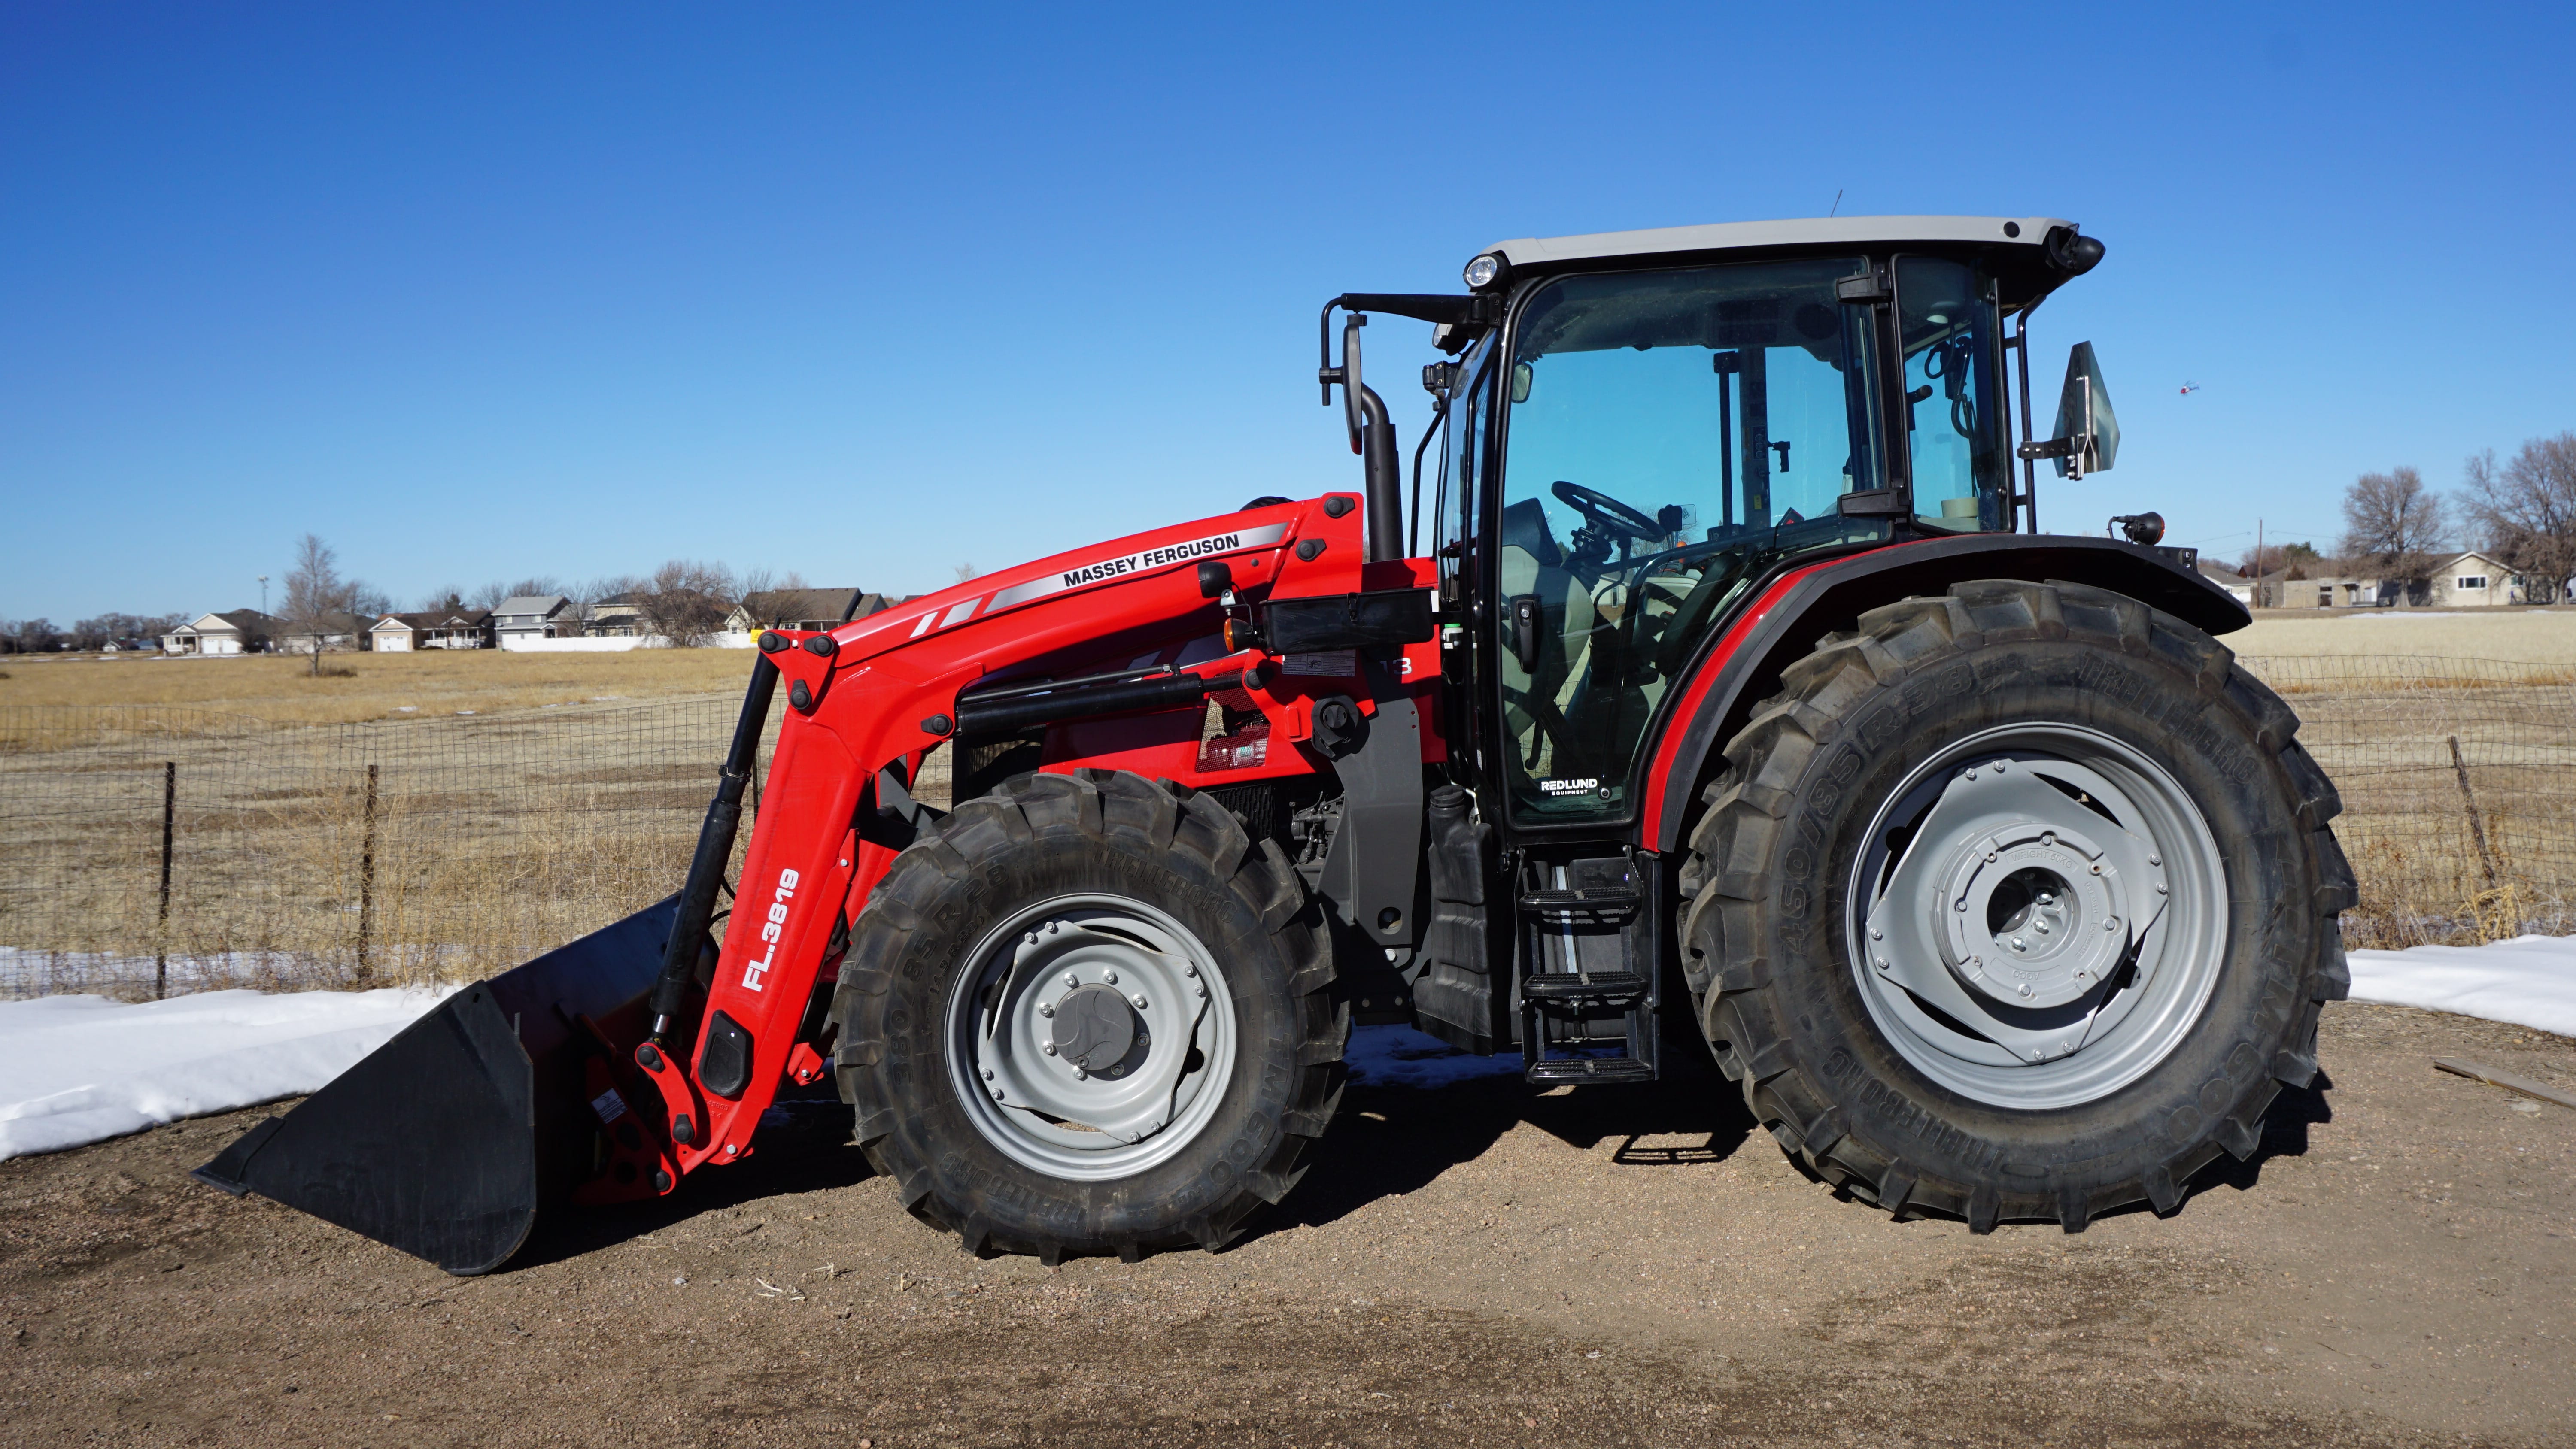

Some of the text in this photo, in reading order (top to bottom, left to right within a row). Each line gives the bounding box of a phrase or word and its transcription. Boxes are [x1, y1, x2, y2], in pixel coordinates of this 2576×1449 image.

[1063, 534, 1240, 587] MASSEY FERGUSON
[2078, 651, 2260, 785] TRELLEBORG
[1541, 779, 1598, 791] REDLUND
[1779, 664, 1972, 956] 460/85 R 38
[1092, 841, 1238, 923] TRELLEBORG
[2011, 850, 2073, 868] WEIGHT 50KG
[742, 868, 799, 992] FL.3819
[890, 864, 1009, 1085] 380/85 R 28
[2012, 970, 2040, 980] AGCO
[1209, 1033, 1292, 1185] TM 600
[1821, 1050, 2007, 1175] TRELLEBORG
[2167, 1043, 2261, 1143] 600
[939, 1153, 1091, 1231] TRELLEBORG
